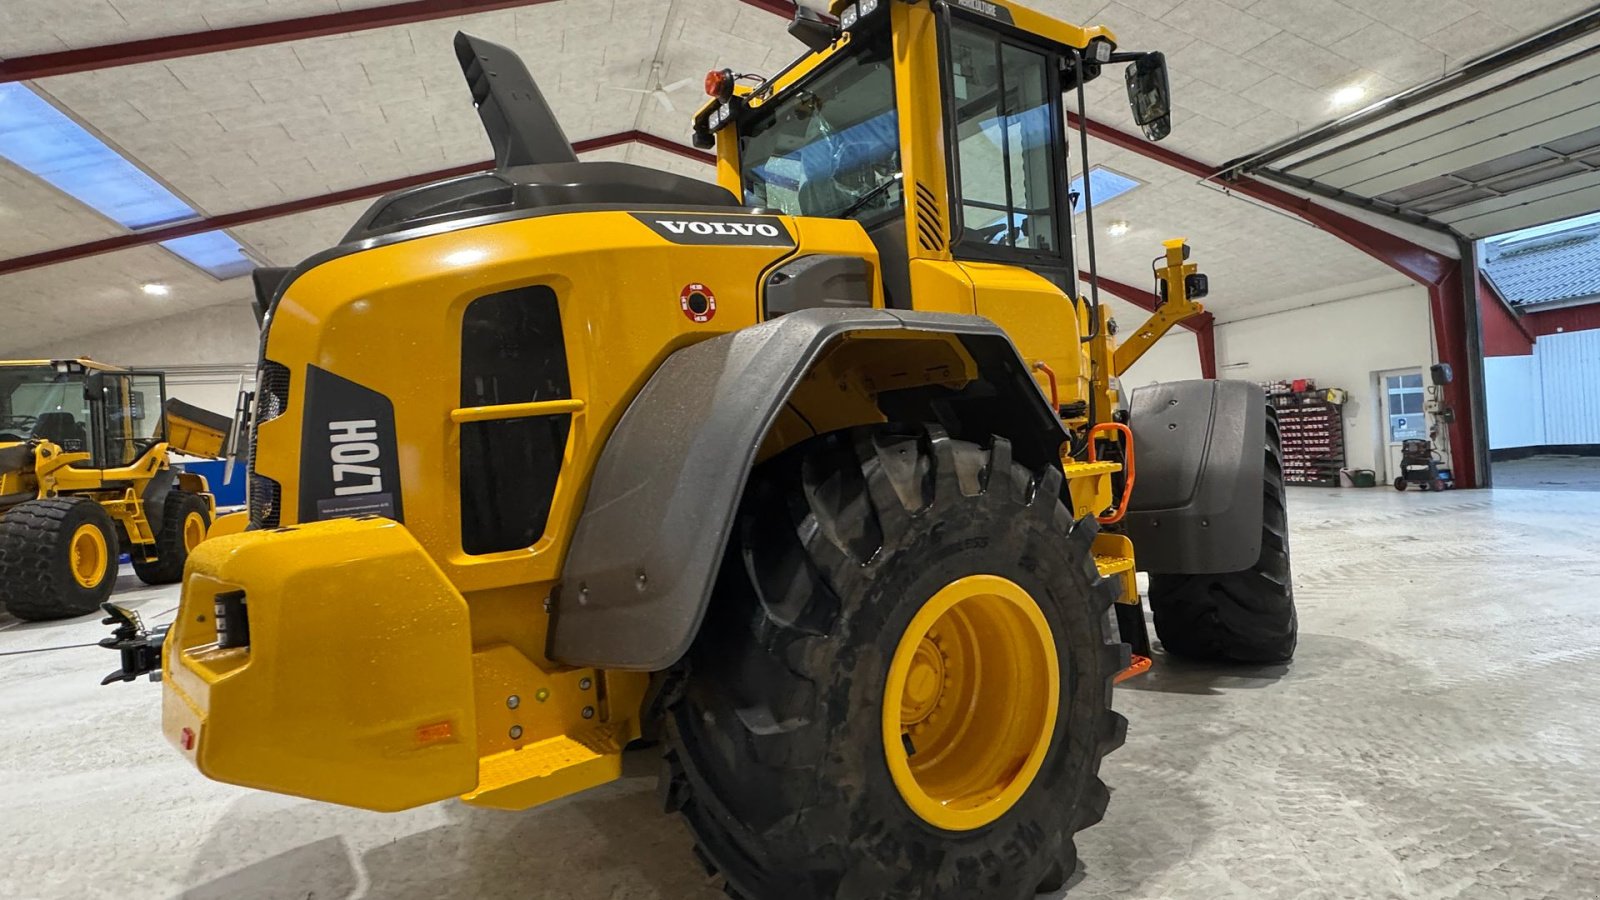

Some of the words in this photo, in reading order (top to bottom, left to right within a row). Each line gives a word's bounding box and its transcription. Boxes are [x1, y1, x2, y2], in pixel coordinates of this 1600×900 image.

[655, 220, 779, 237] VOLVO
[1398, 418, 1407, 429] P
[328, 419, 382, 496] L70H
